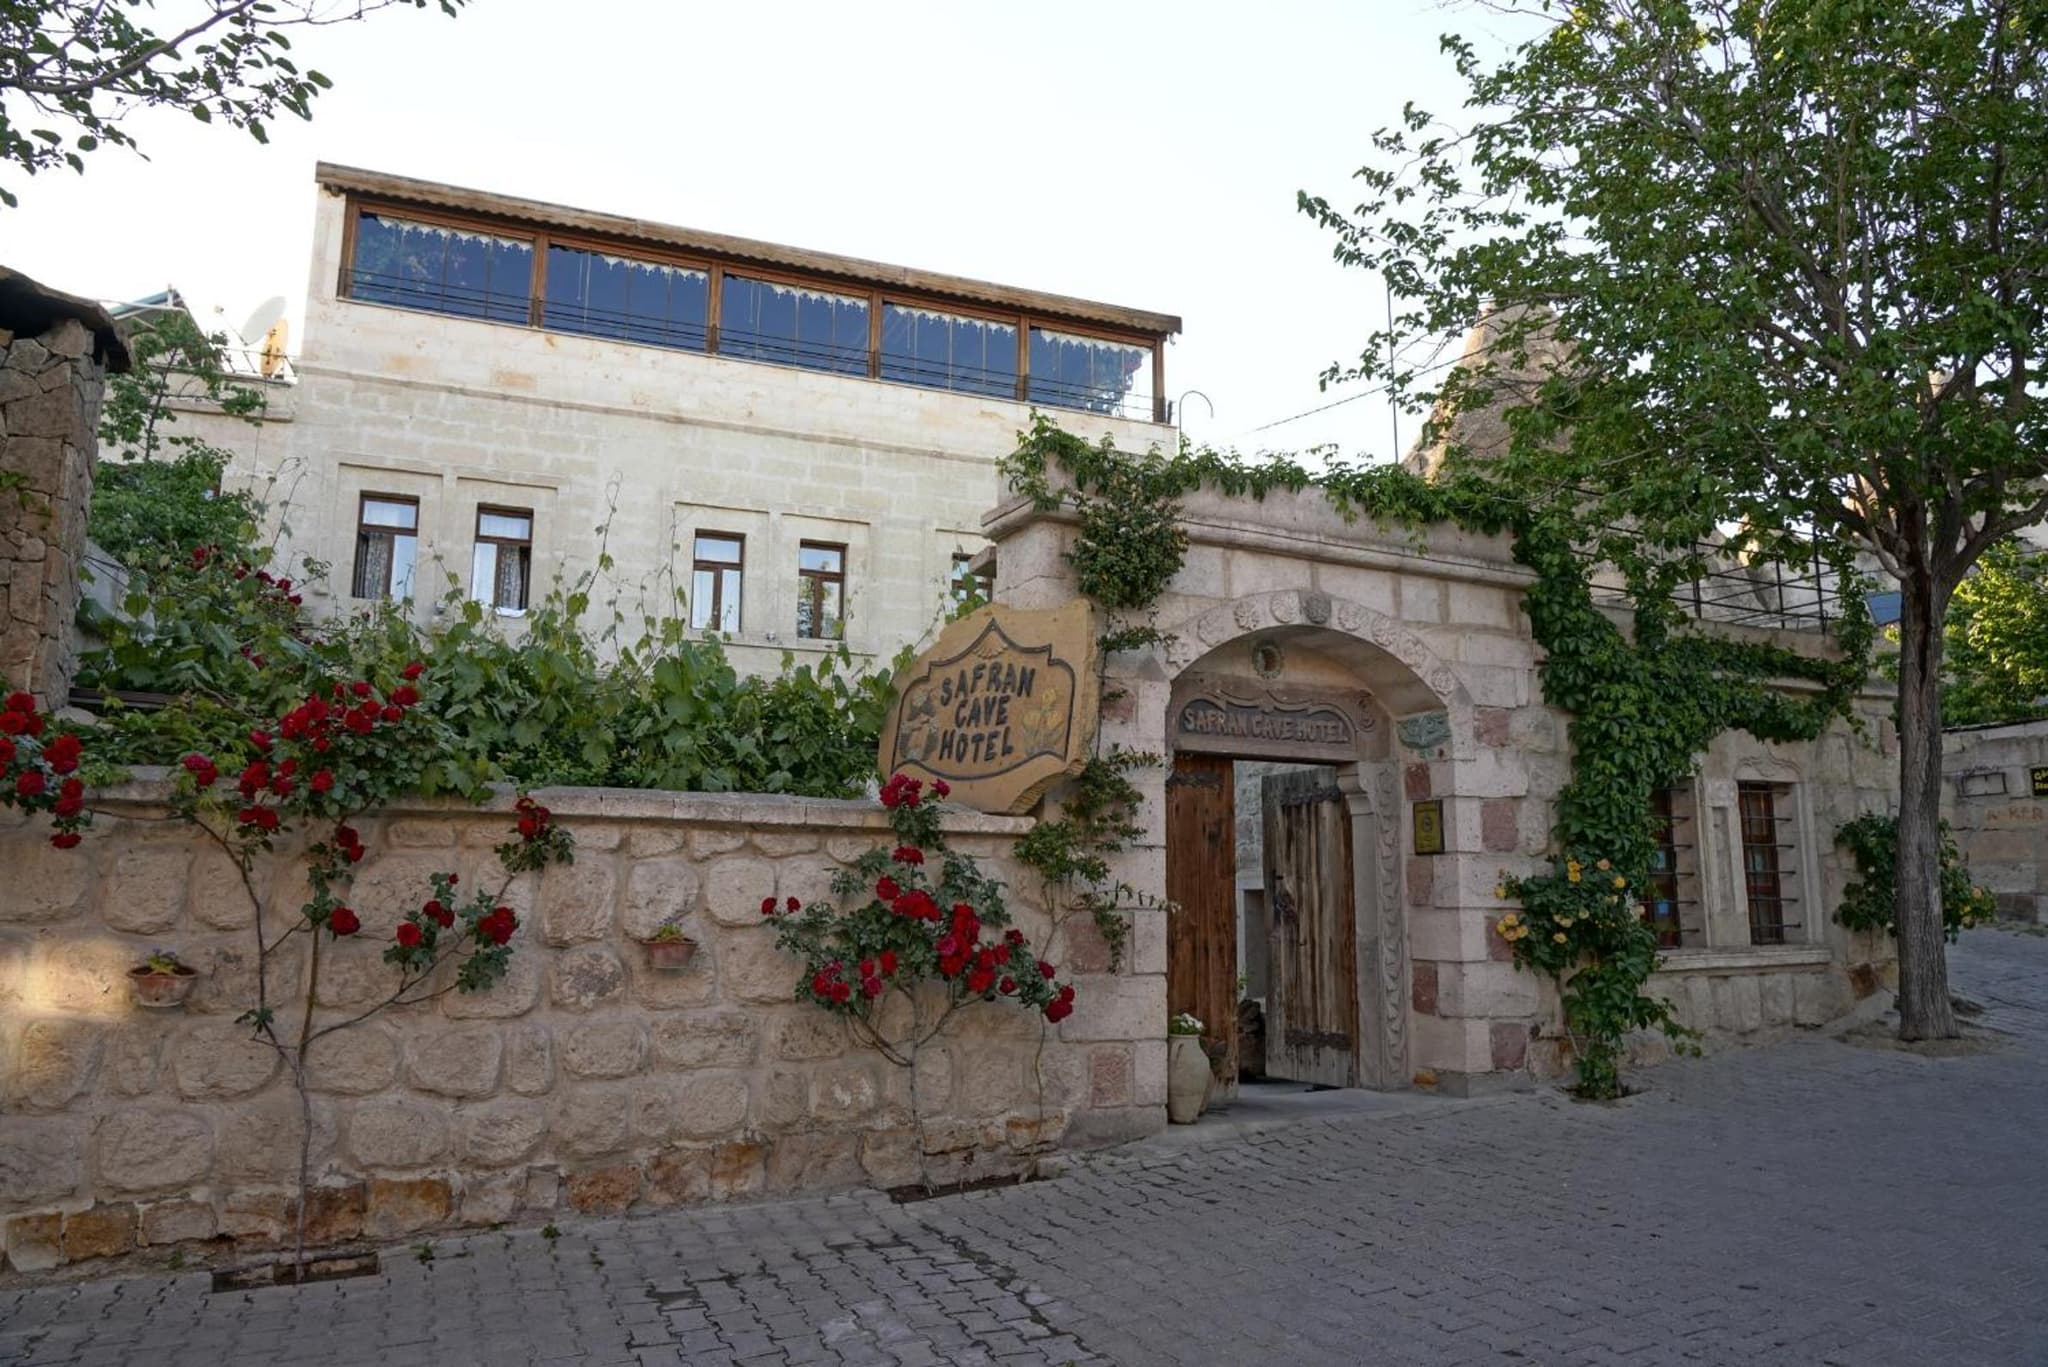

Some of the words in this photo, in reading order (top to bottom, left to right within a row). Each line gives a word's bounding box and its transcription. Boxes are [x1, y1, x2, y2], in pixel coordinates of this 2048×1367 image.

[940, 661, 1036, 706] SAFRAN
[955, 694, 1010, 728] CAVE
[1184, 708, 1249, 737] SAFRAN
[1250, 714, 1294, 741] CAVE
[1296, 718, 1350, 743] HOTEL
[938, 727, 1014, 763] HOTEL
